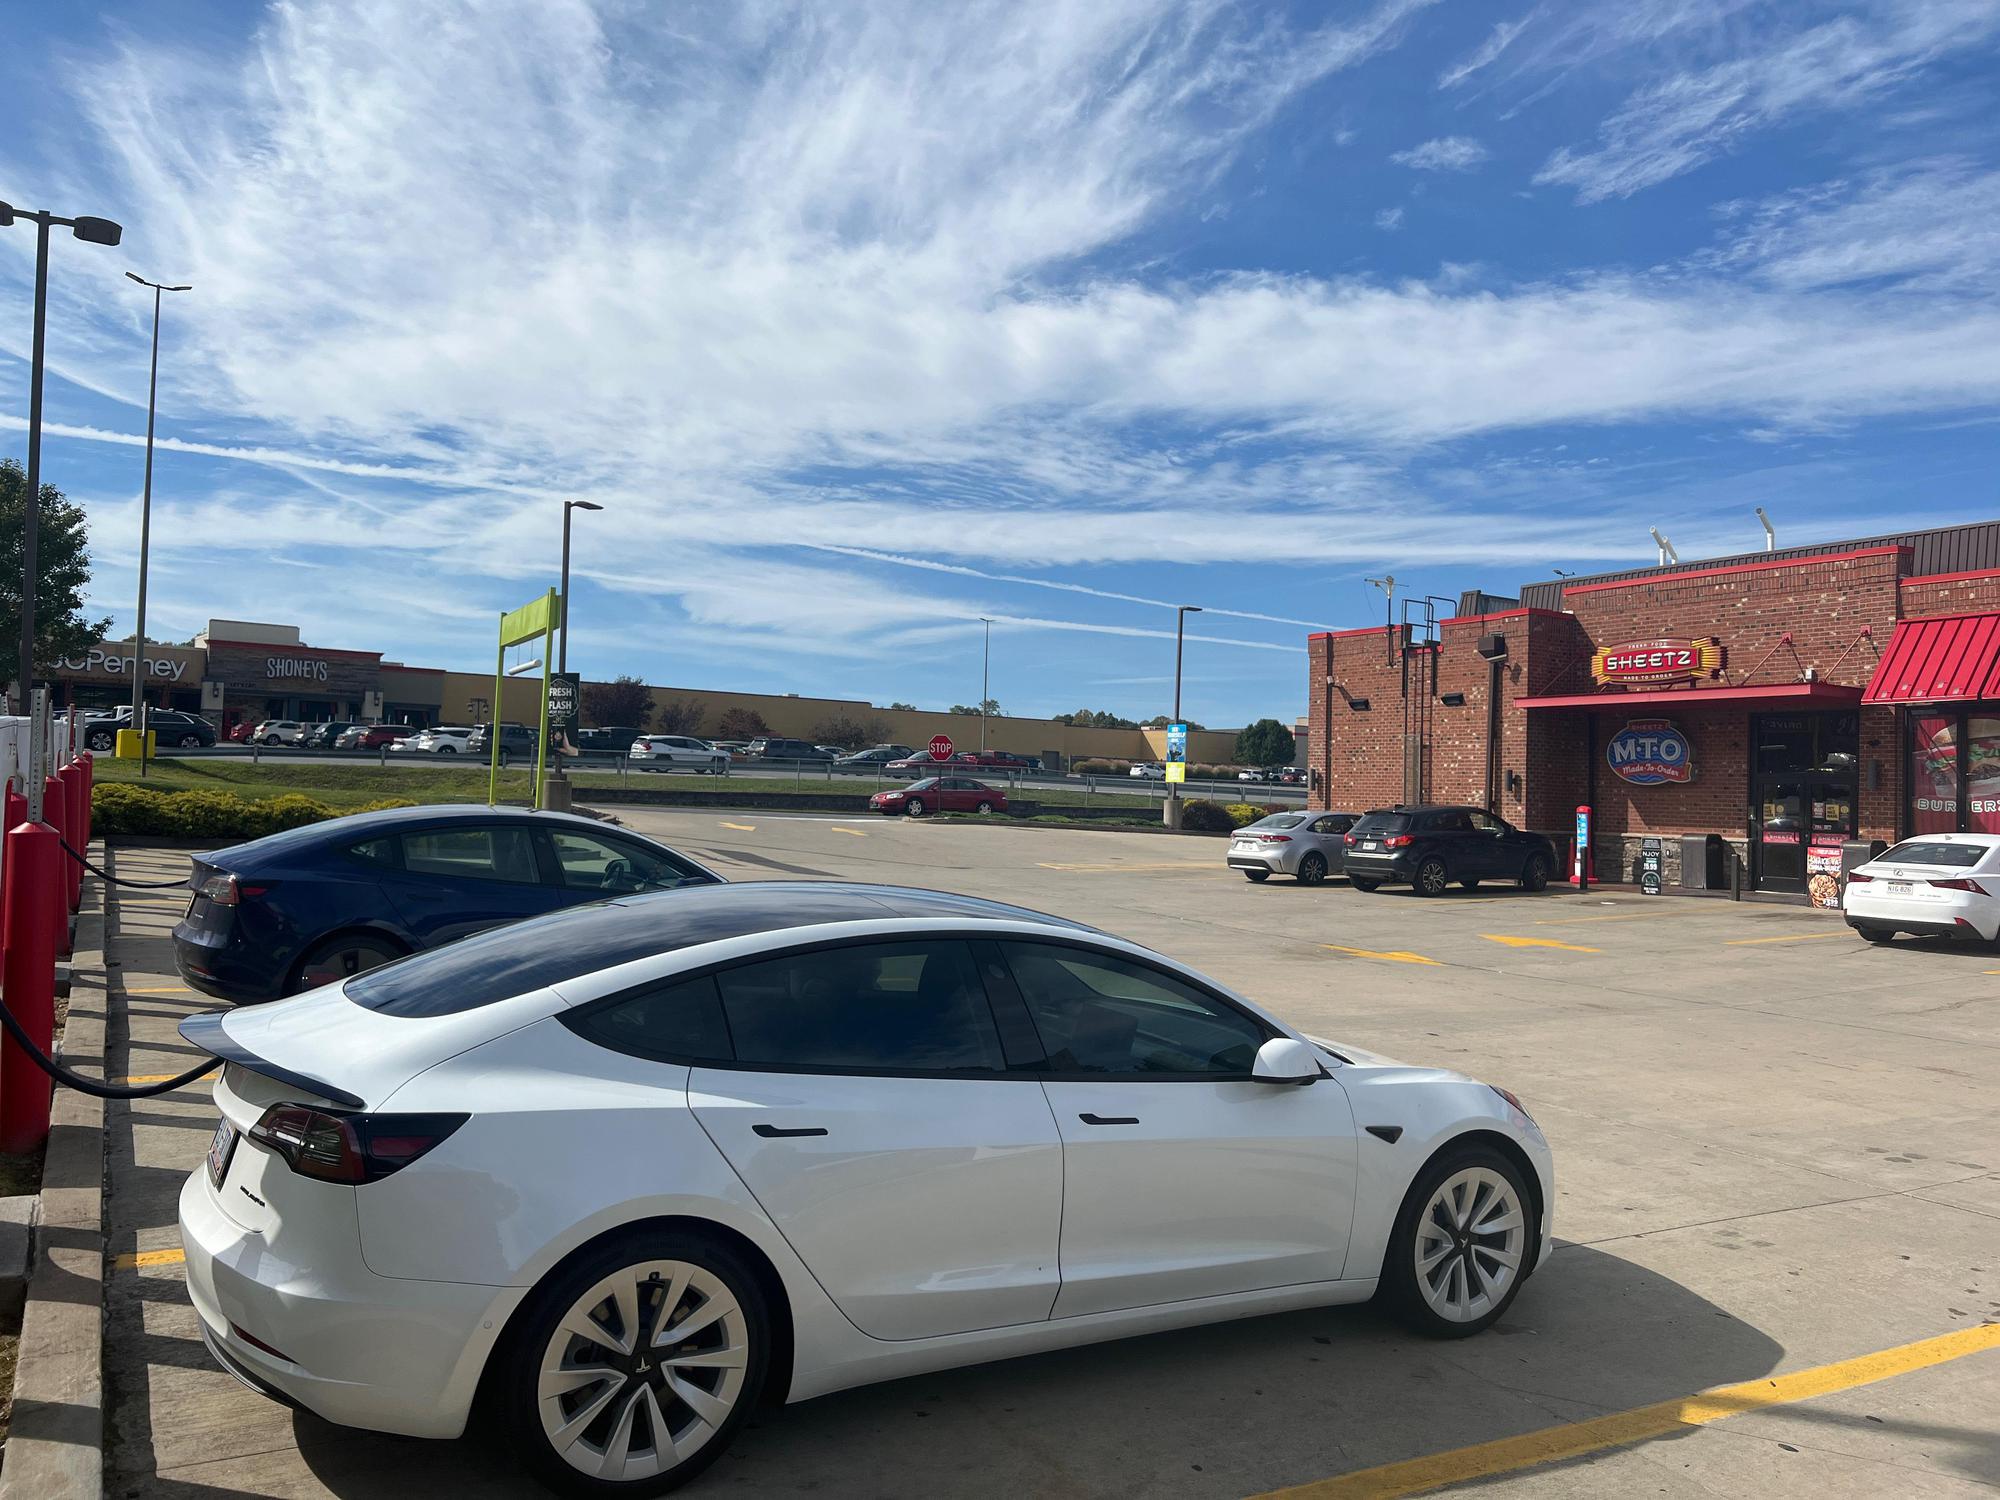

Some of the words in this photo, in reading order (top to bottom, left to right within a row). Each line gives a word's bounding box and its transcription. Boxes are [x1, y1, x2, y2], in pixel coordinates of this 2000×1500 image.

[1607, 650, 1691, 670] SHEETZ
[548, 687, 572, 697] FRESH
[548, 700, 572, 710] FLASH
[930, 742, 952, 753] STOP
